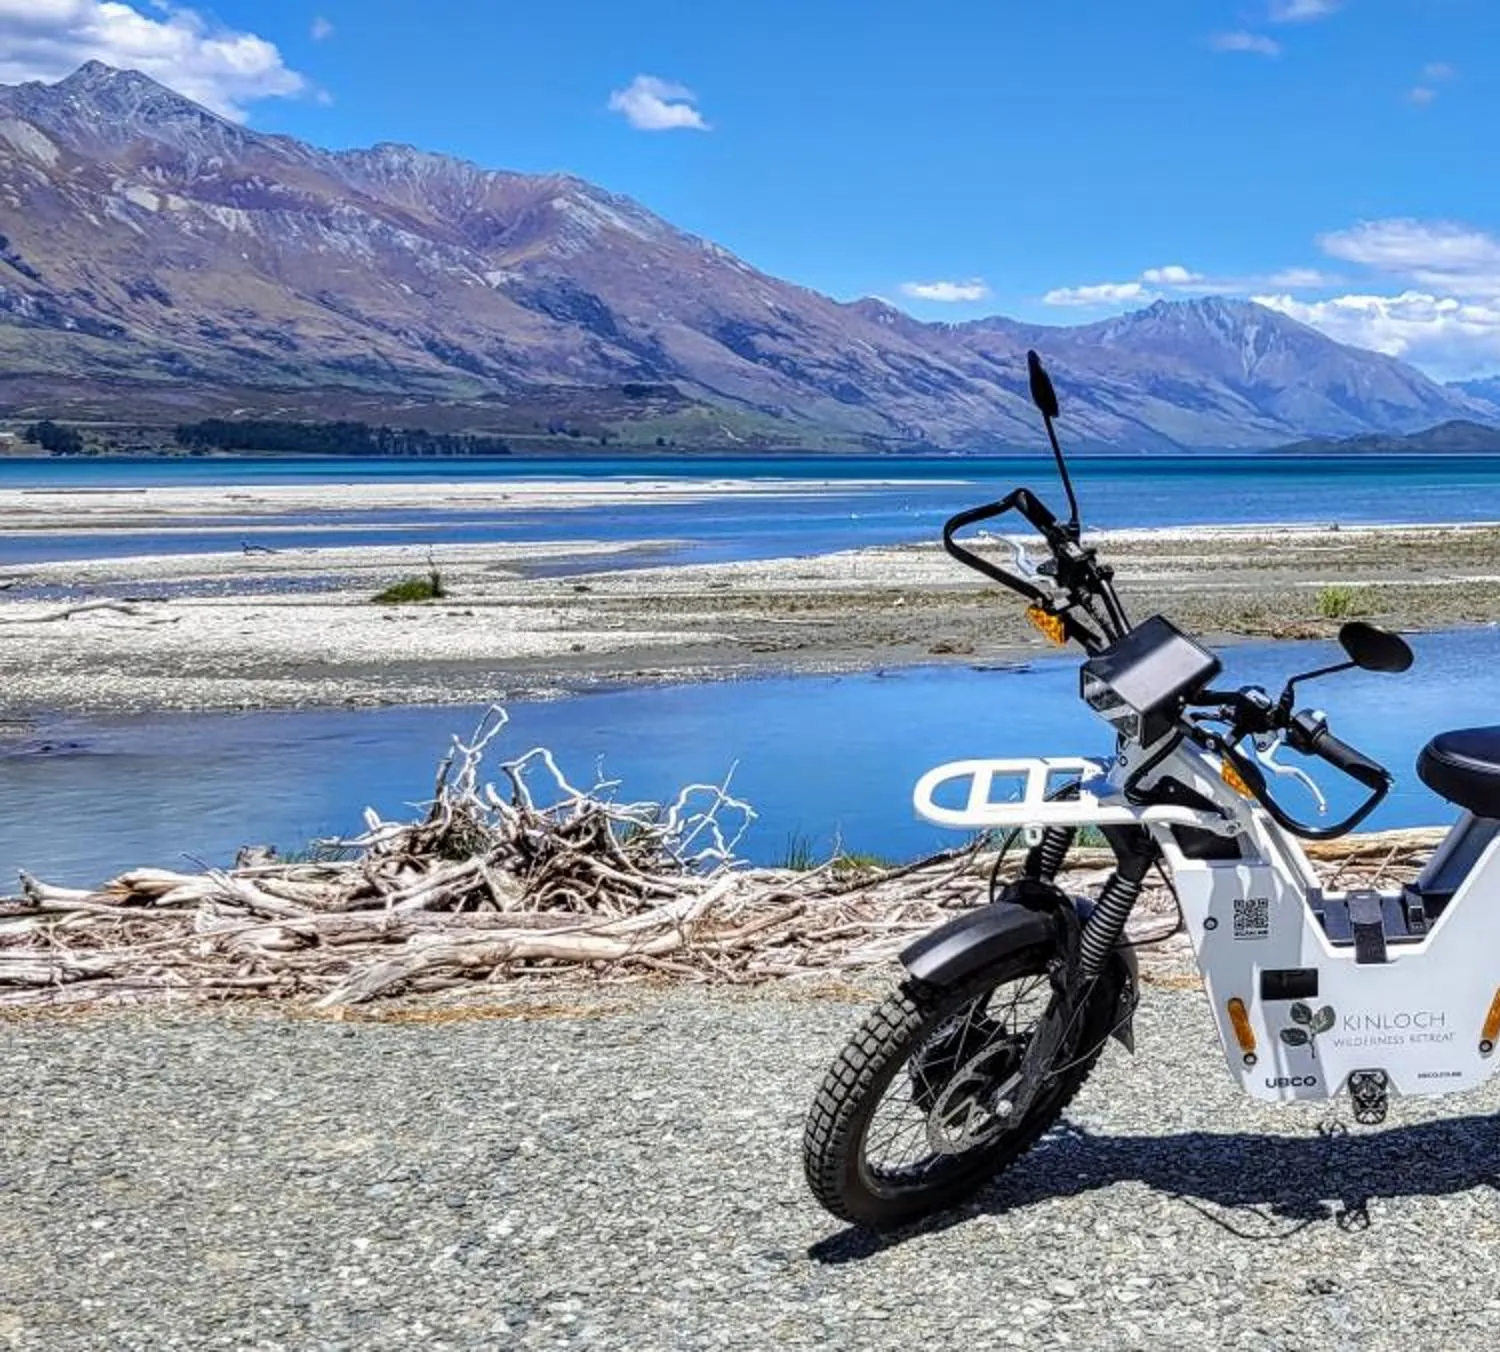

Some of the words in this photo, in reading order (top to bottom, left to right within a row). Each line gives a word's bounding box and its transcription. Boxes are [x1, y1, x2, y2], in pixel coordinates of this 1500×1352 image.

[1343, 1011, 1445, 1031] KINLOCH
[1333, 1034, 1405, 1047] WILDERNESS
[1409, 1031, 1455, 1043] RETREAT
[1265, 1076, 1317, 1088] UBCO
